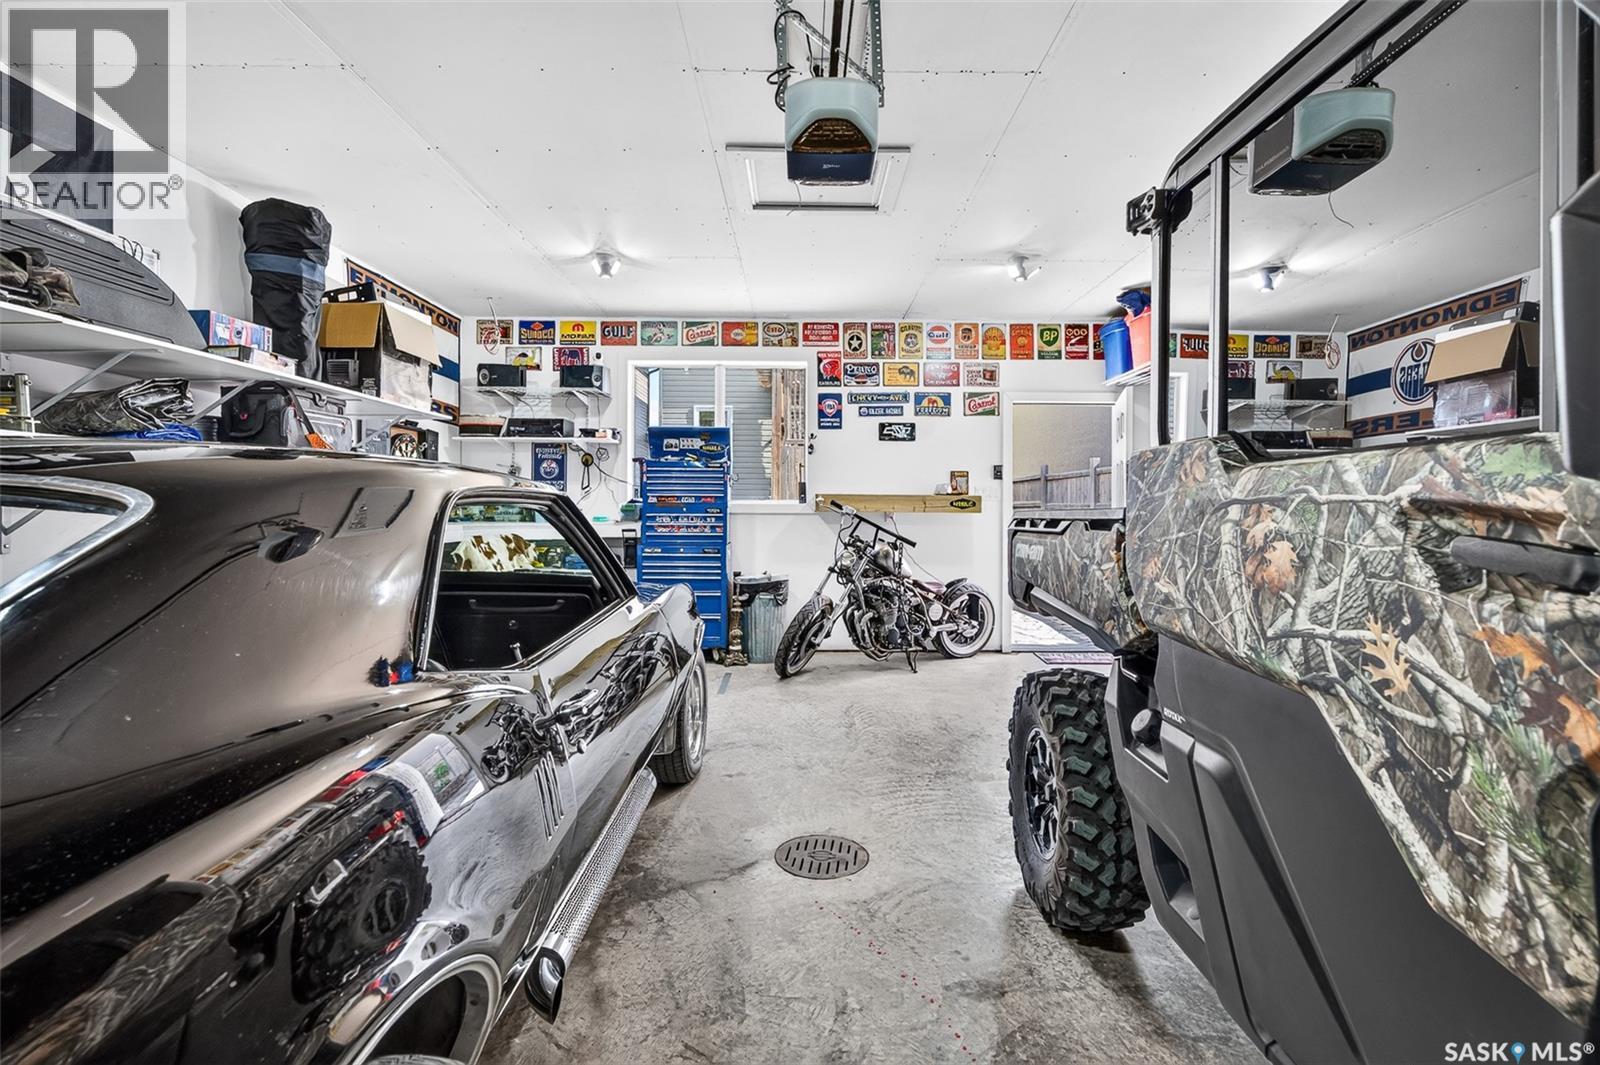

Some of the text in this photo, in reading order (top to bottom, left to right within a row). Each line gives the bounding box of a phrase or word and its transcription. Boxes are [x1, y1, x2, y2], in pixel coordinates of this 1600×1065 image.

[520, 328, 554, 340] SUNOCO
[602, 325, 635, 339] GULF
[686, 325, 716, 343] Castrol
[1043, 330, 1058, 341] BP
[968, 395, 996, 413] Castrol
